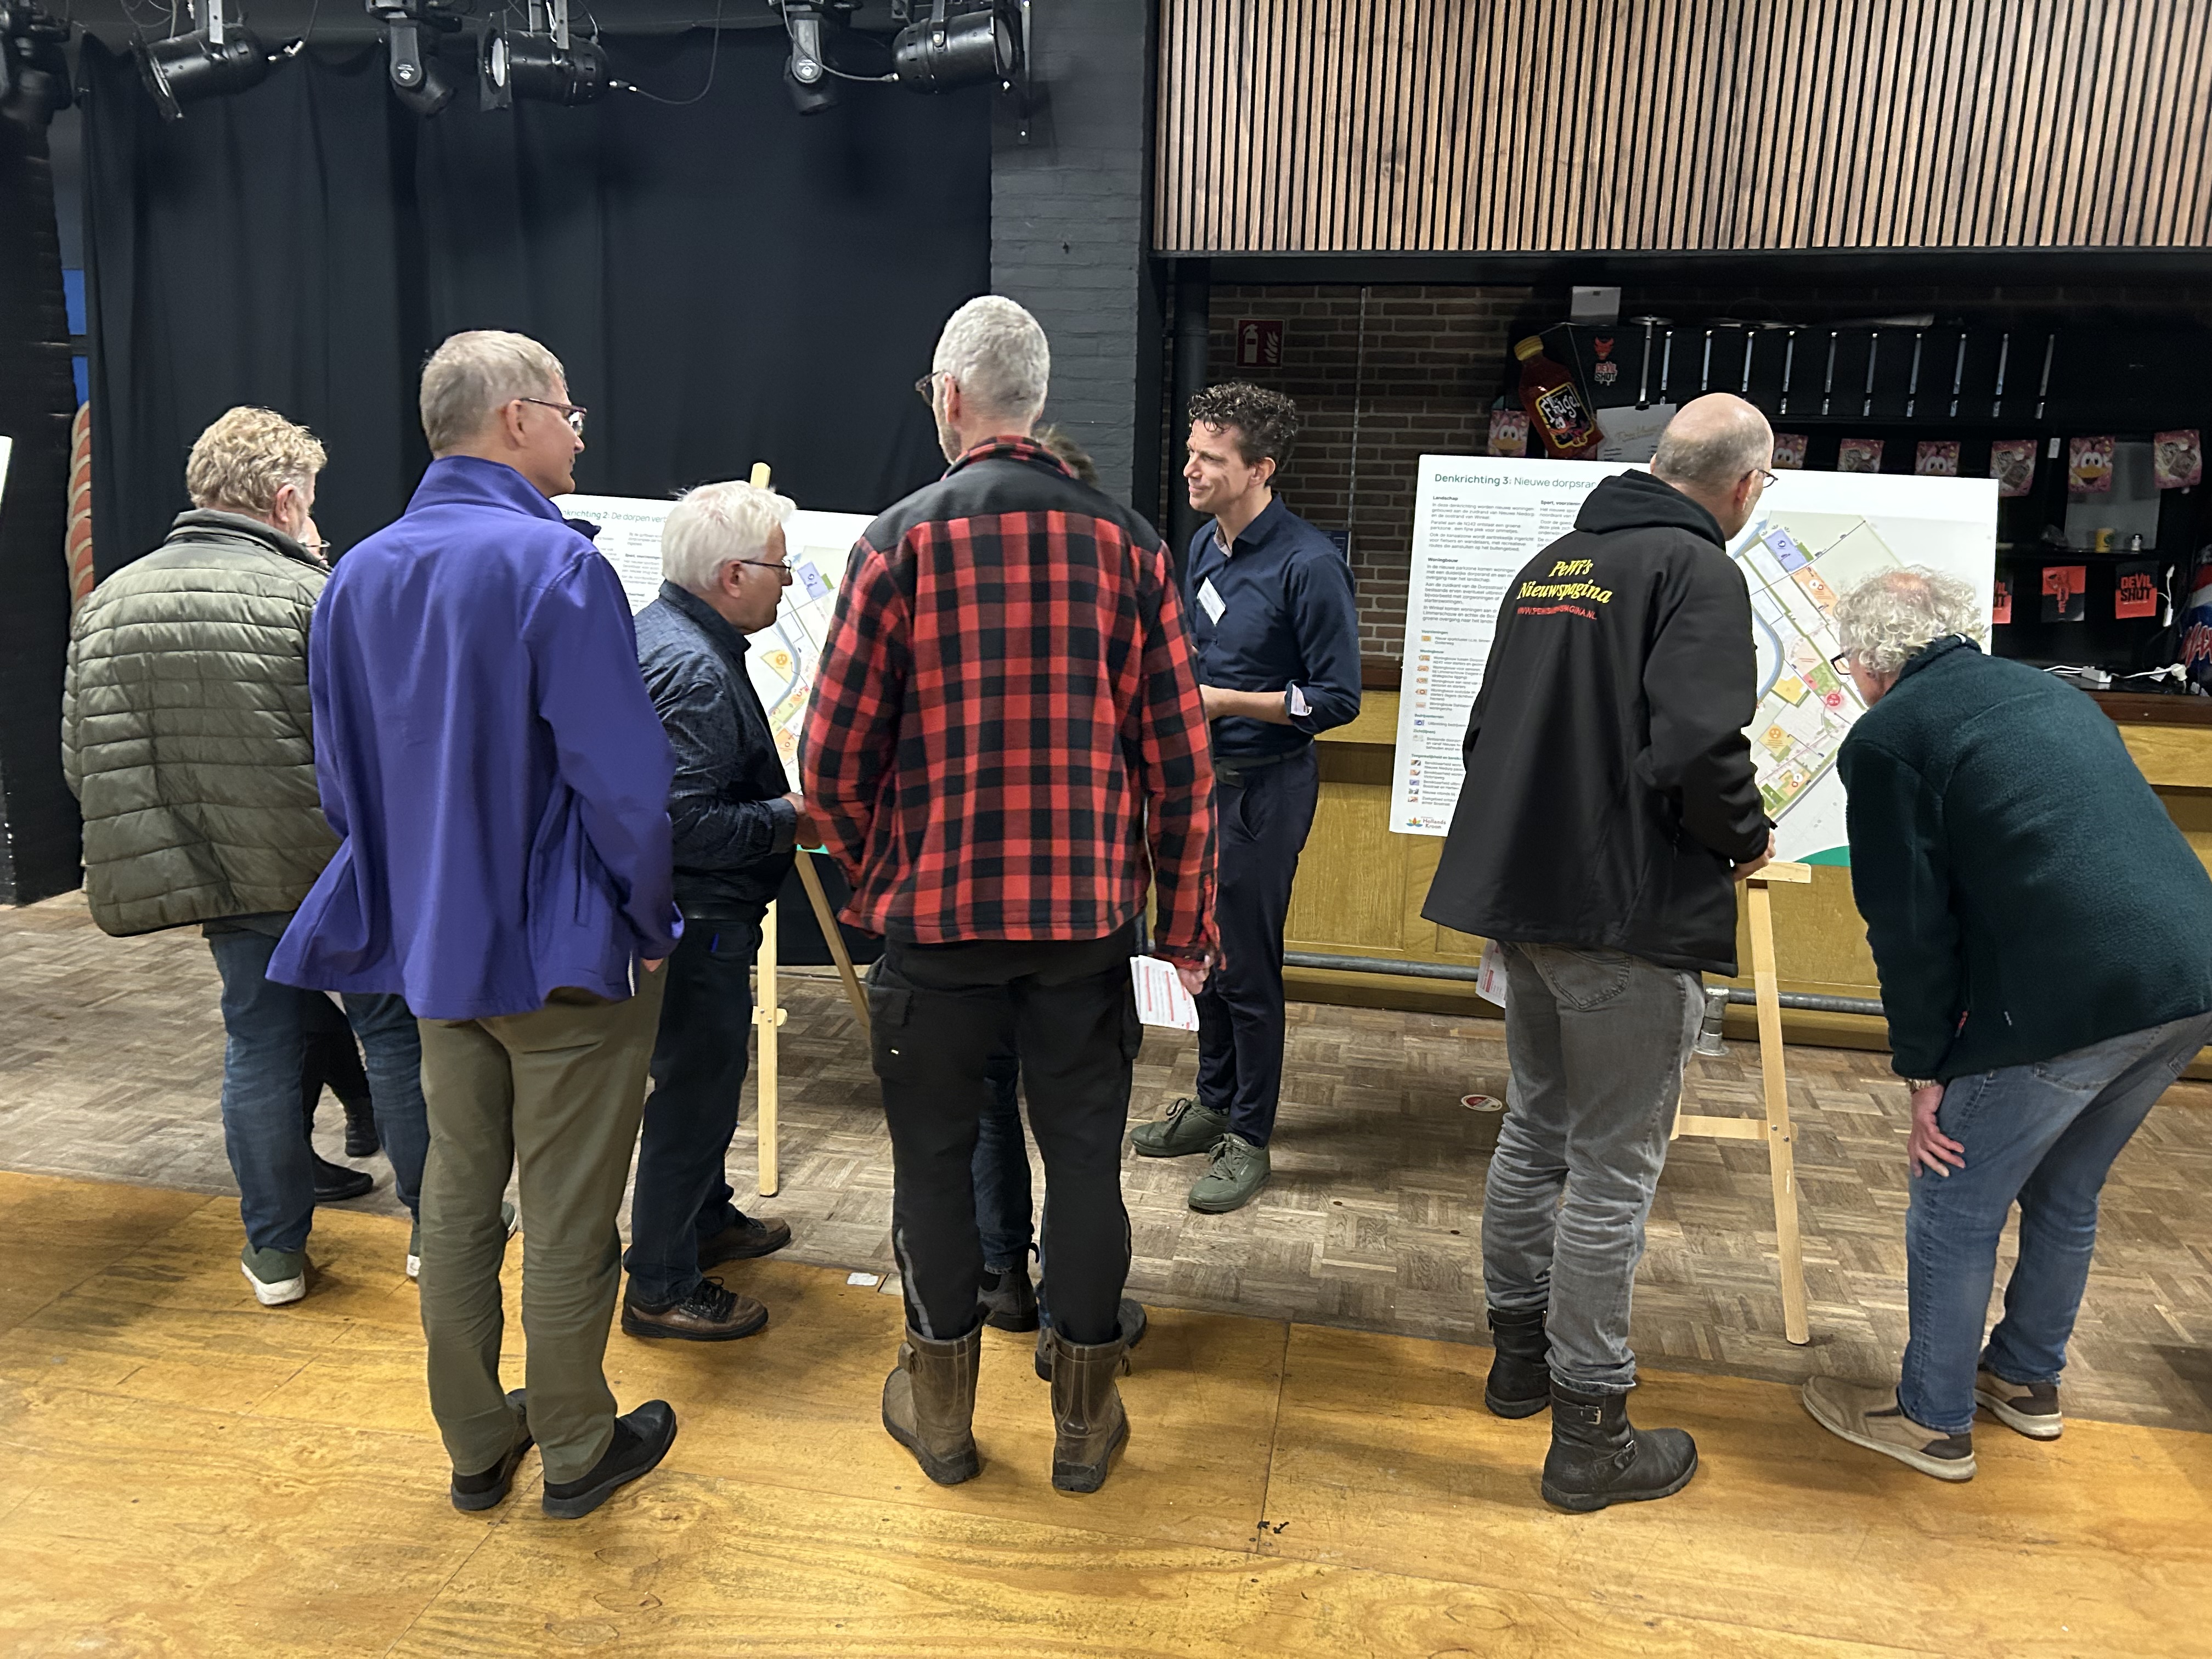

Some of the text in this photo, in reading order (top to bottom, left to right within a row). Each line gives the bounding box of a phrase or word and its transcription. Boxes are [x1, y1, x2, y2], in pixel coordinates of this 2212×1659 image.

[1541, 385, 1580, 422] Flügel
[1435, 474, 1500, 486] Denkrichting
[1503, 476, 1512, 485] 3:
[1514, 477, 1550, 487] Nieuwe
[623, 513, 650, 522] dorpen
[2121, 573, 2153, 589] DEVIL
[1516, 579, 1613, 603] Nieuwspagina
[2121, 588, 2151, 602] SHOT
